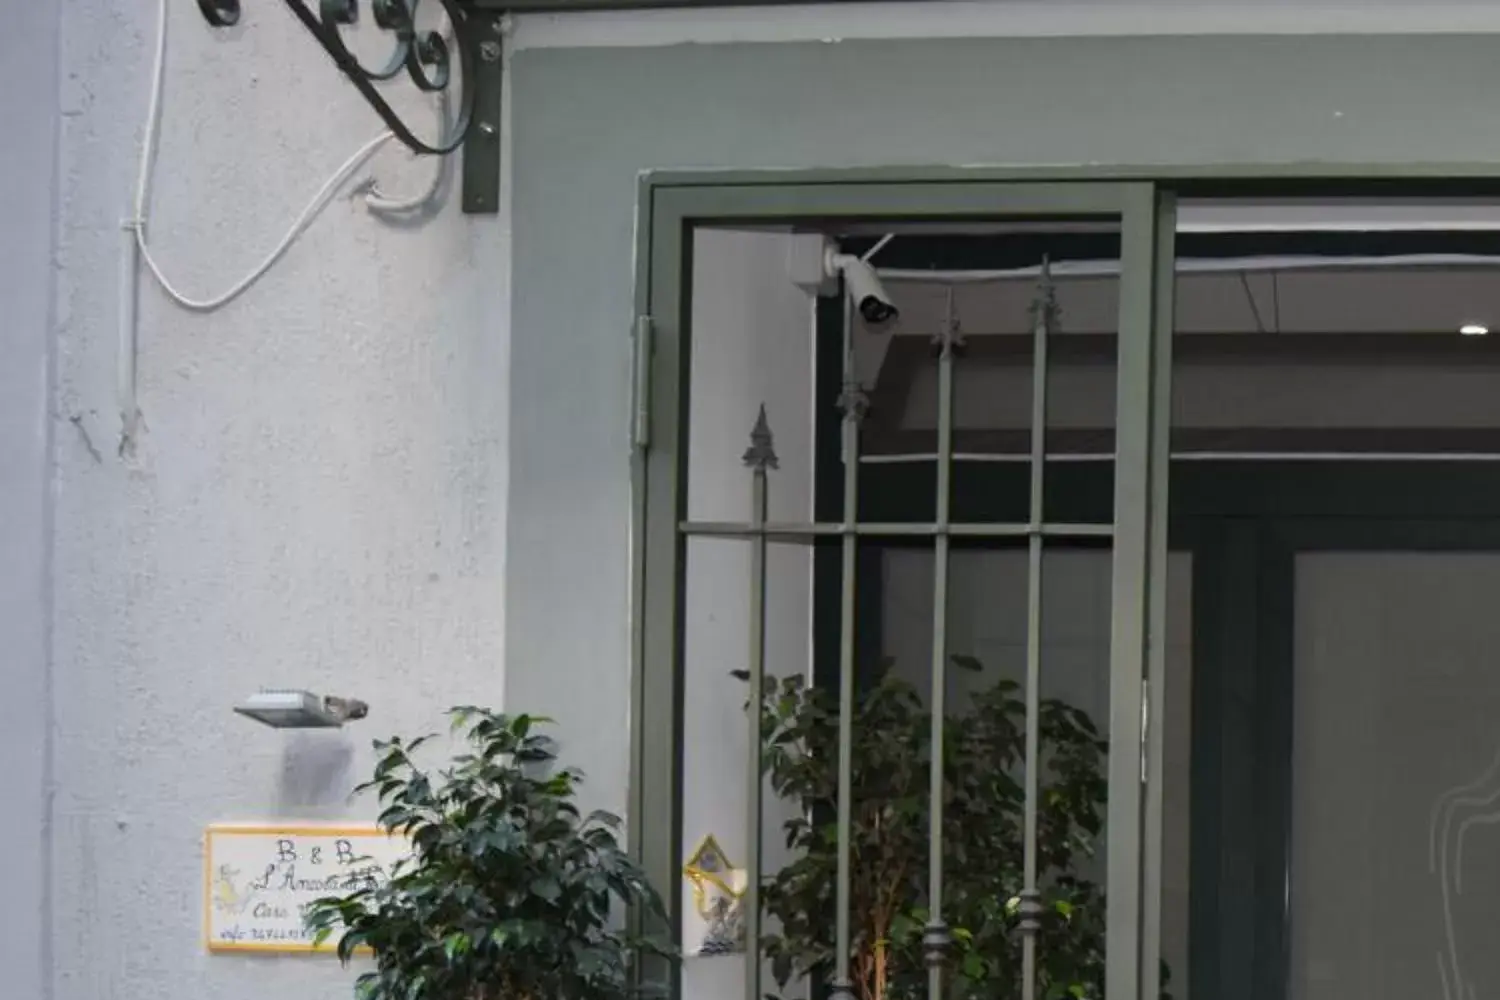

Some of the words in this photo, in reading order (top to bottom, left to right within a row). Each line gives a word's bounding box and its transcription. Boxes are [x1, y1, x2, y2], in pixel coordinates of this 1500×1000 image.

[276, 839, 297, 862] B
[310, 846, 323, 865] &
[335, 839, 353, 865] B
